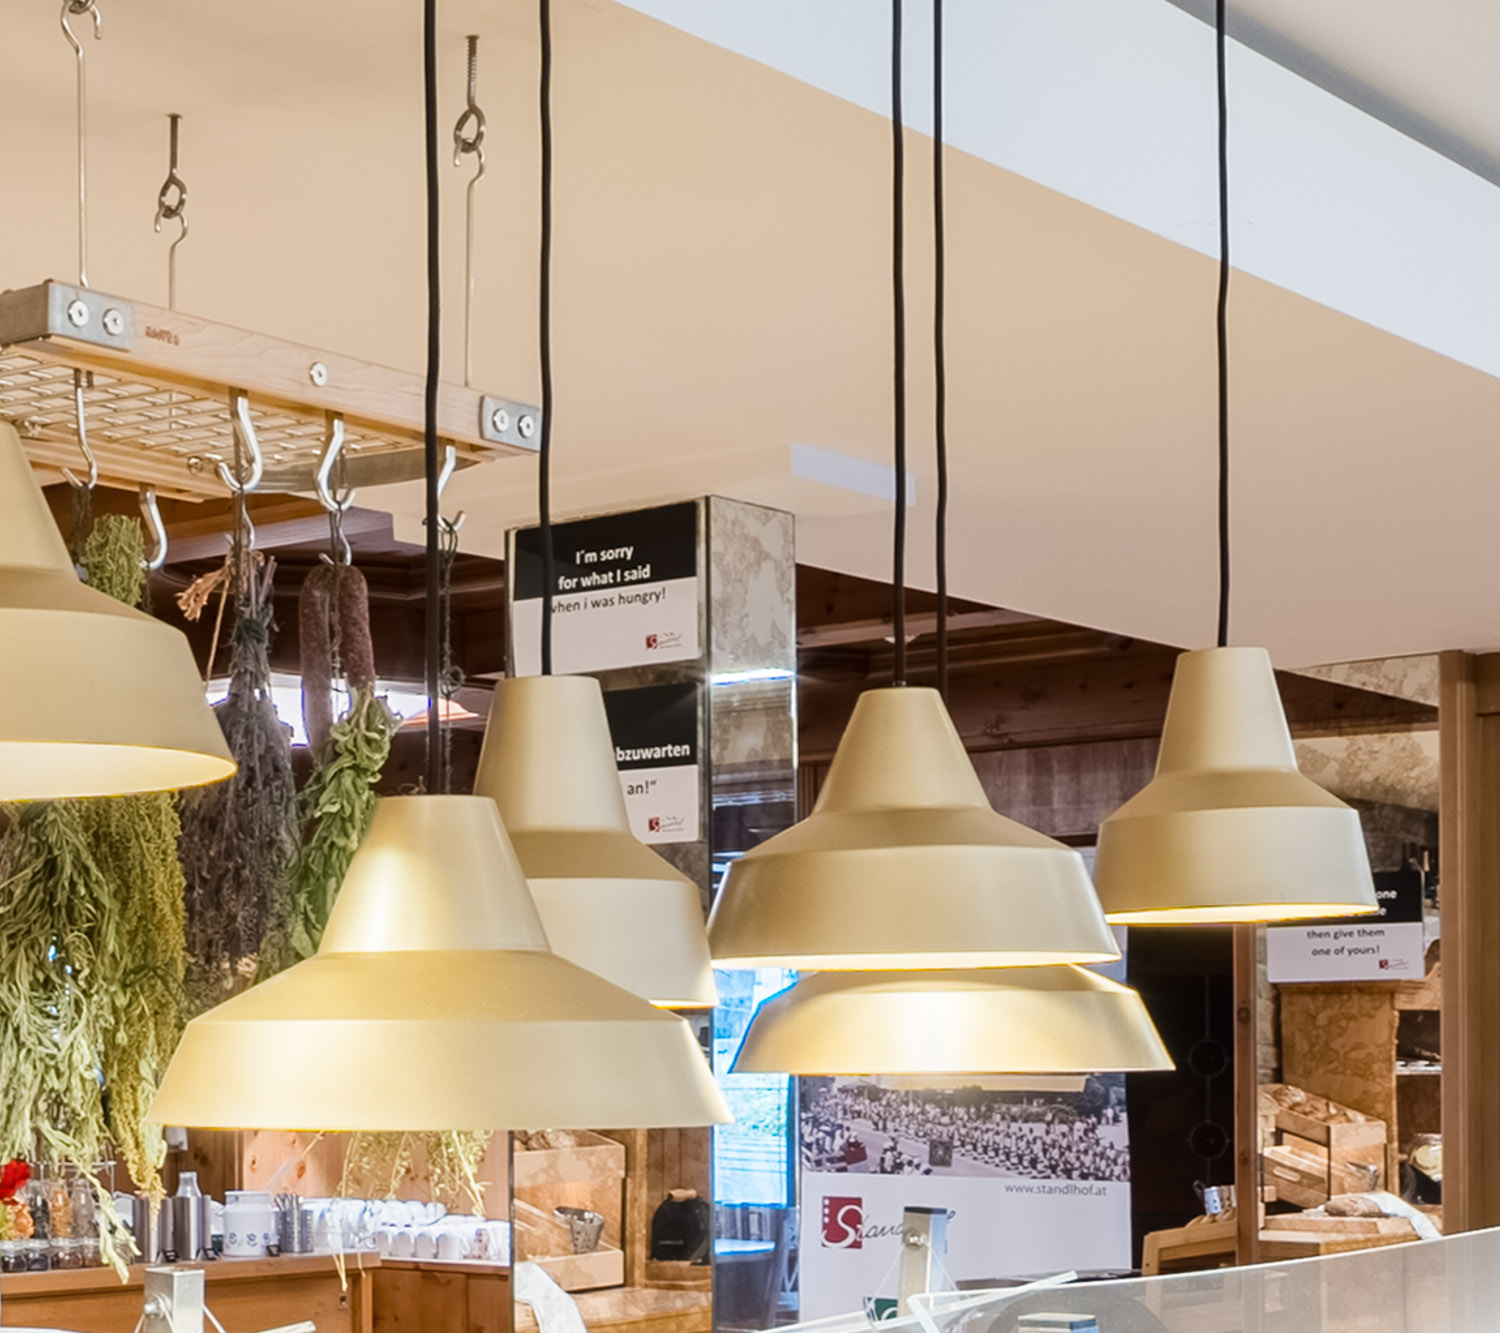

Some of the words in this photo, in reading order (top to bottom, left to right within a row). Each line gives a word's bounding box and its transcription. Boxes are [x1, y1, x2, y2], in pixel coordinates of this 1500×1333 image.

[600, 546, 634, 561] sorry
[558, 576, 578, 590] for
[580, 572, 614, 588] what
[623, 564, 651, 581] said
[590, 597, 615, 609] was
[618, 586, 667, 606] hungry!
[616, 743, 690, 761] bzuwarten
[1306, 929, 1331, 939] then
[1333, 928, 1354, 940] give
[1357, 927, 1385, 938] them
[1311, 947, 1331, 956] one
[1334, 945, 1345, 956] of
[1346, 944, 1380, 957] yours!
[1004, 1183, 1107, 1198] www.standlhof.at
